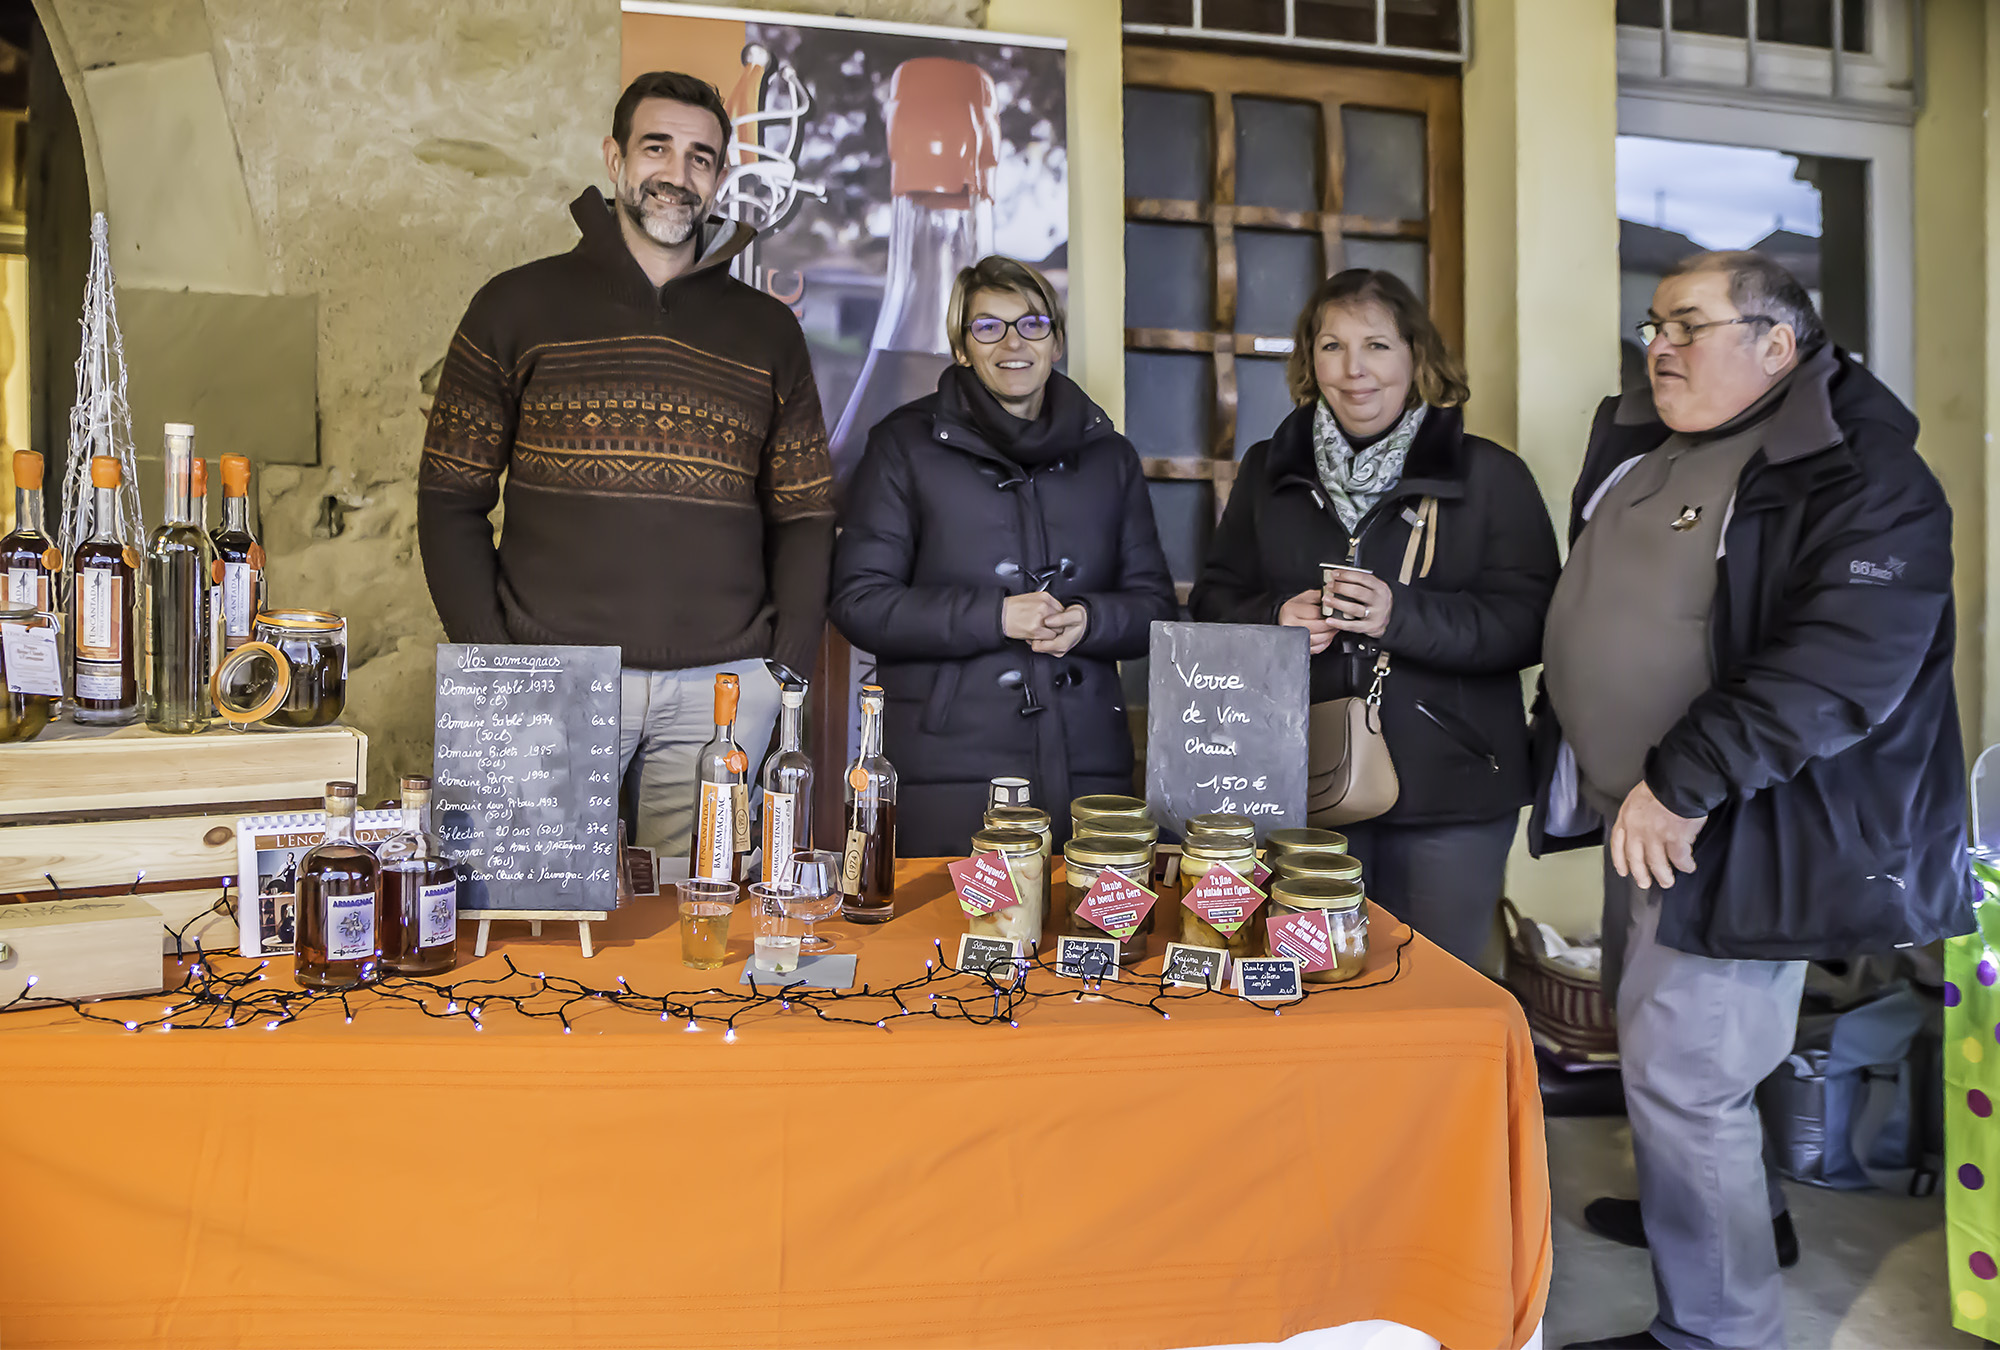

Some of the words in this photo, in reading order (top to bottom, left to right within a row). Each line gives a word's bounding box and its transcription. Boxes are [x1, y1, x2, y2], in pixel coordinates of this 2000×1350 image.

[458, 647, 487, 669] Nos
[494, 654, 561, 677] armagnacs
[1176, 662, 1245, 690] Verre
[439, 678, 487, 695] Domaine
[492, 679, 524, 695] Sablé
[525, 679, 556, 694] 1973
[1182, 700, 1207, 724] de
[1216, 706, 1251, 724] Vin
[437, 713, 485, 730] Domaine
[492, 712, 524, 727] Sablé
[526, 713, 553, 727] 1974
[437, 744, 482, 759] Domaine
[437, 769, 481, 787] Domaine
[435, 798, 482, 811] Domaine
[1210, 796, 1237, 815] le
[1243, 801, 1285, 816] verre
[715, 797, 726, 851] ARMAGNAC
[438, 825, 485, 841] Sélection
[512, 827, 530, 837] ans
[713, 853, 721, 869] BAS
[975, 858, 1007, 880] Blanquette
[974, 870, 984, 880] de
[983, 875, 998, 888] veau
[1101, 880, 1122, 892] Daube
[1209, 875, 1232, 887] Tajine
[424, 884, 456, 897] ARMAGNAC
[1088, 896, 1097, 907] de
[1116, 891, 1126, 900] du
[1126, 888, 1142, 899] Gers
[1196, 888, 1203, 897] de
[1203, 887, 1222, 898] pintade
[1223, 887, 1233, 896] aux
[1234, 885, 1250, 896] figues
[332, 897, 373, 909] ARMAGNAC
[967, 951, 977, 960] de
[1202, 956, 1213, 967] de
[1268, 963, 1276, 972] de
